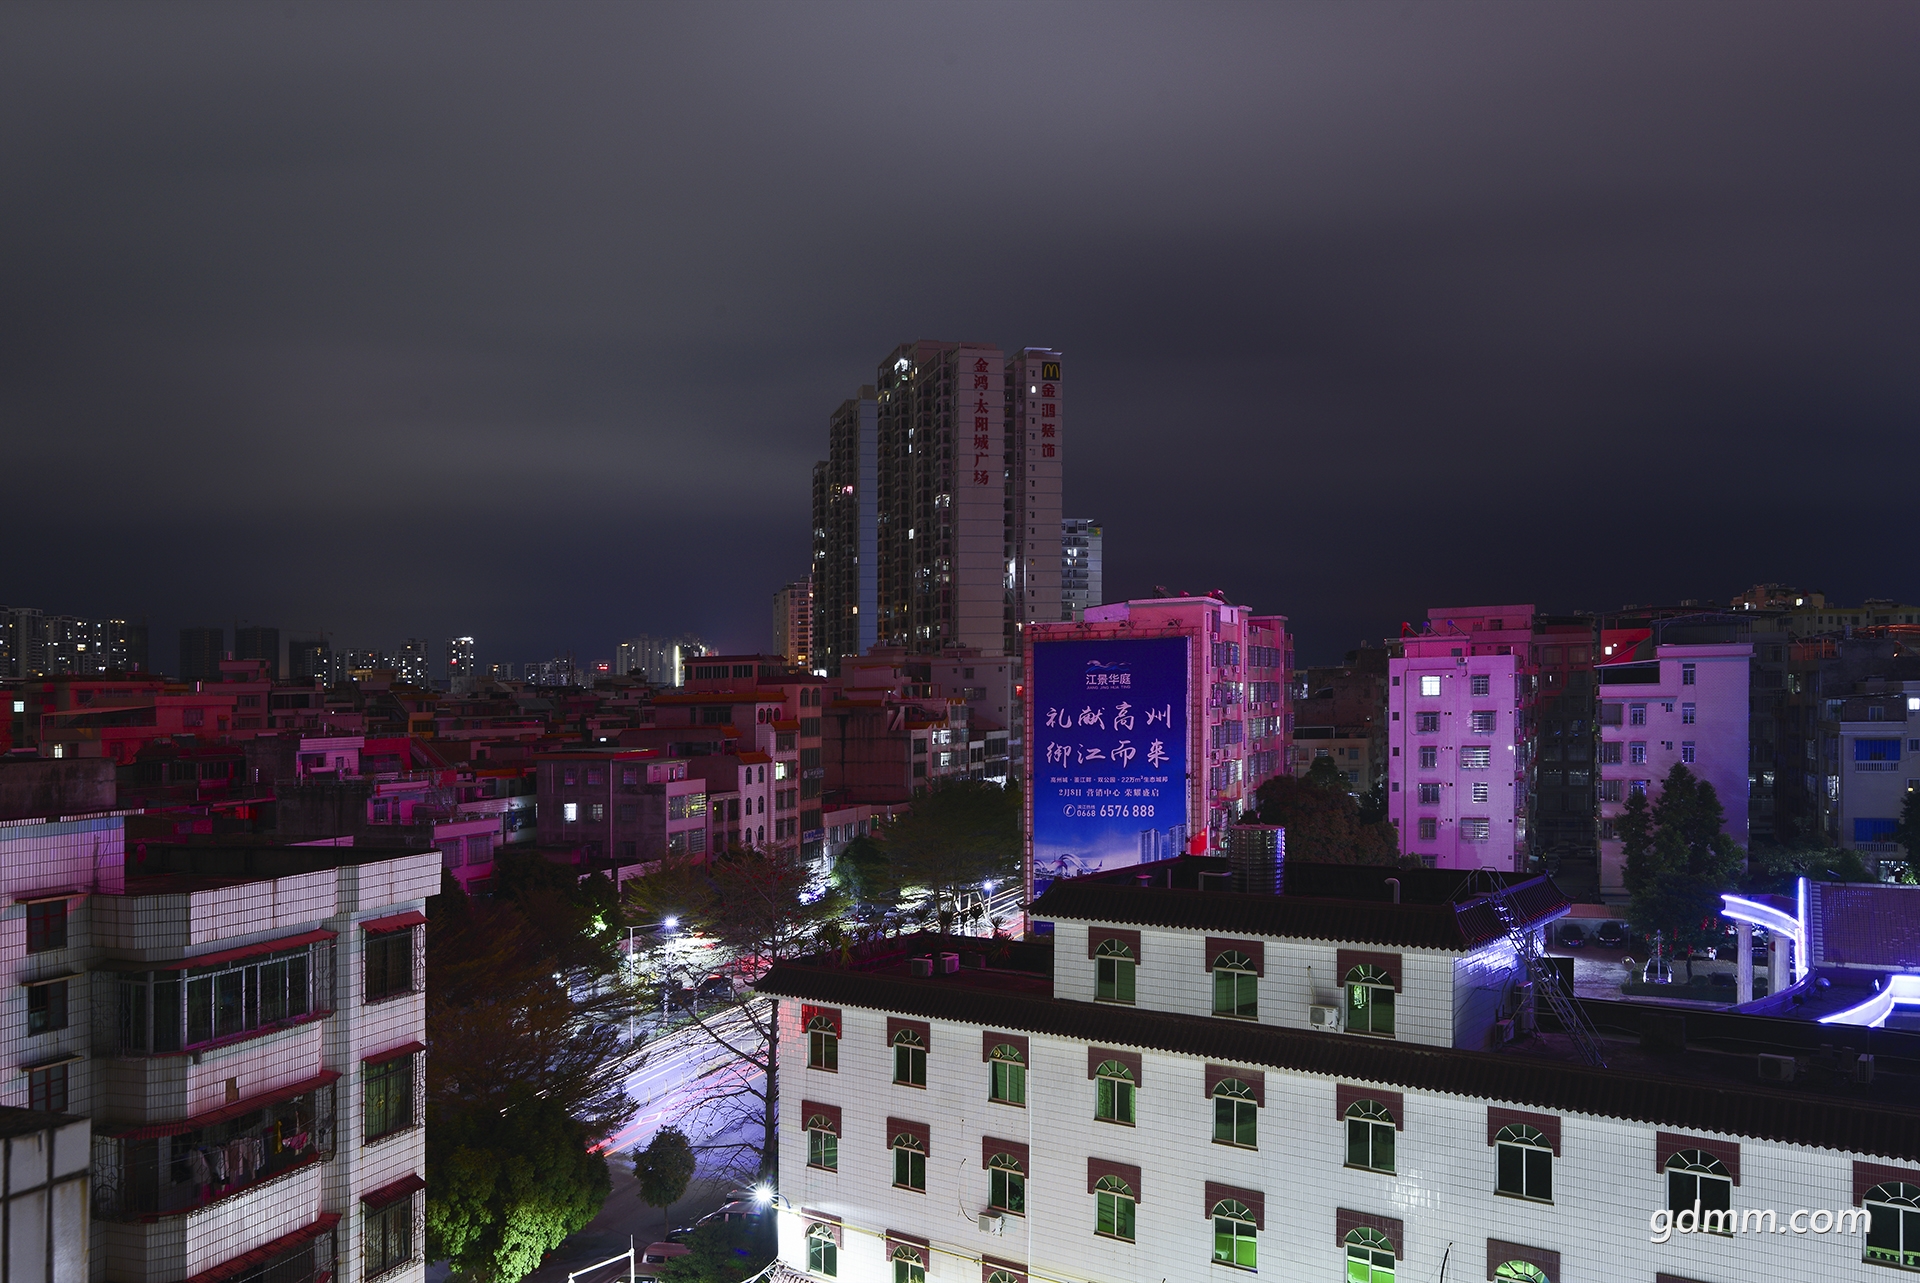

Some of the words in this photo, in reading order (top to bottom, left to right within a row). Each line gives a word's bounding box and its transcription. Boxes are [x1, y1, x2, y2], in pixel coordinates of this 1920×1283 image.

[1041, 383, 1056, 458] 金鸿装饰
[1086, 673, 1131, 685] 江景华庭
[1045, 701, 1171, 731] 礼献高州
[1046, 738, 1170, 768] 御江而来
[1058, 788, 1082, 797] 2月8日
[1086, 788, 1121, 797] 营销中心
[1076, 809, 1096, 817] 0668
[1100, 804, 1129, 817] 6576
[1132, 804, 1155, 817] 888
